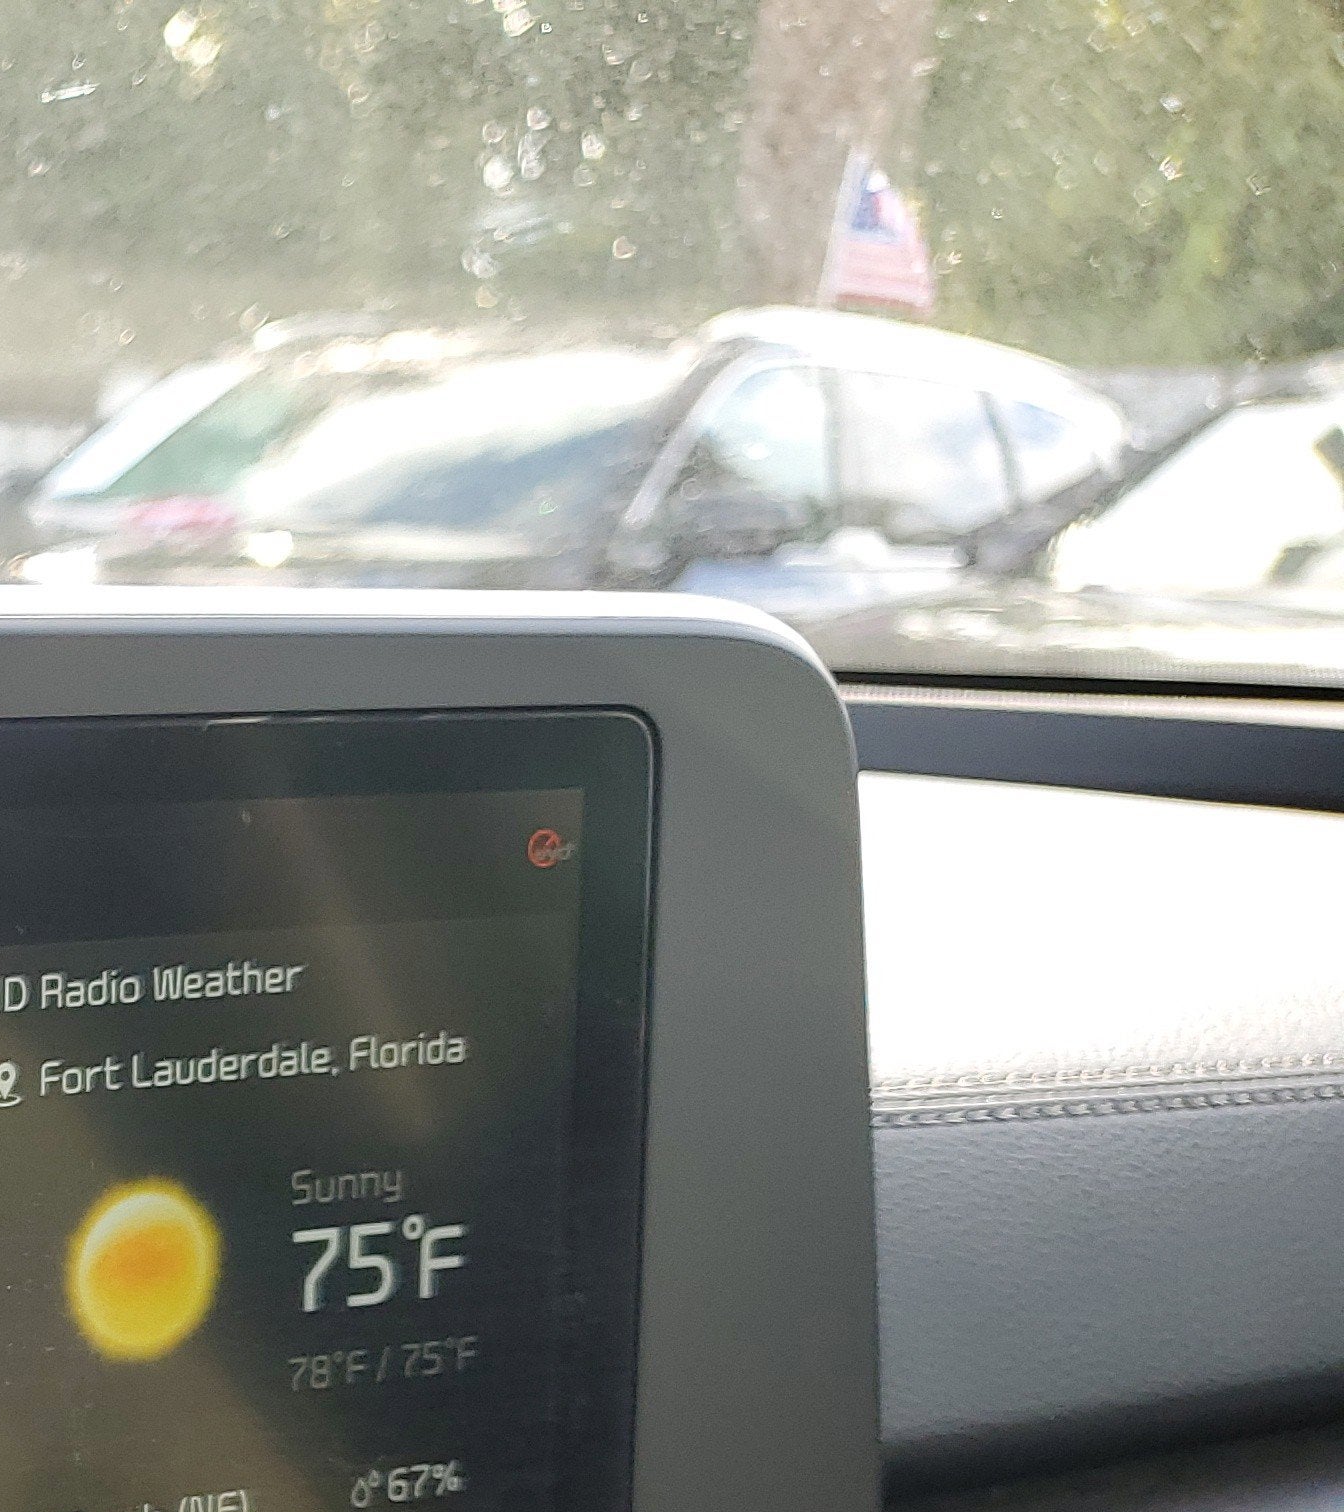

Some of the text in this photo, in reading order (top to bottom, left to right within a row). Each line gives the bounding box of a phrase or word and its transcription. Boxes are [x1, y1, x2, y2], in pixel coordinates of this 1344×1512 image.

[40, 970, 141, 1009] Radio
[152, 961, 306, 1001] Weather
[39, 1031, 467, 1096] Fort Lauderdale, Florida
[291, 1169, 404, 1204] Sunny
[291, 1214, 464, 1312] 75°F
[386, 1461, 462, 1501] 67%
